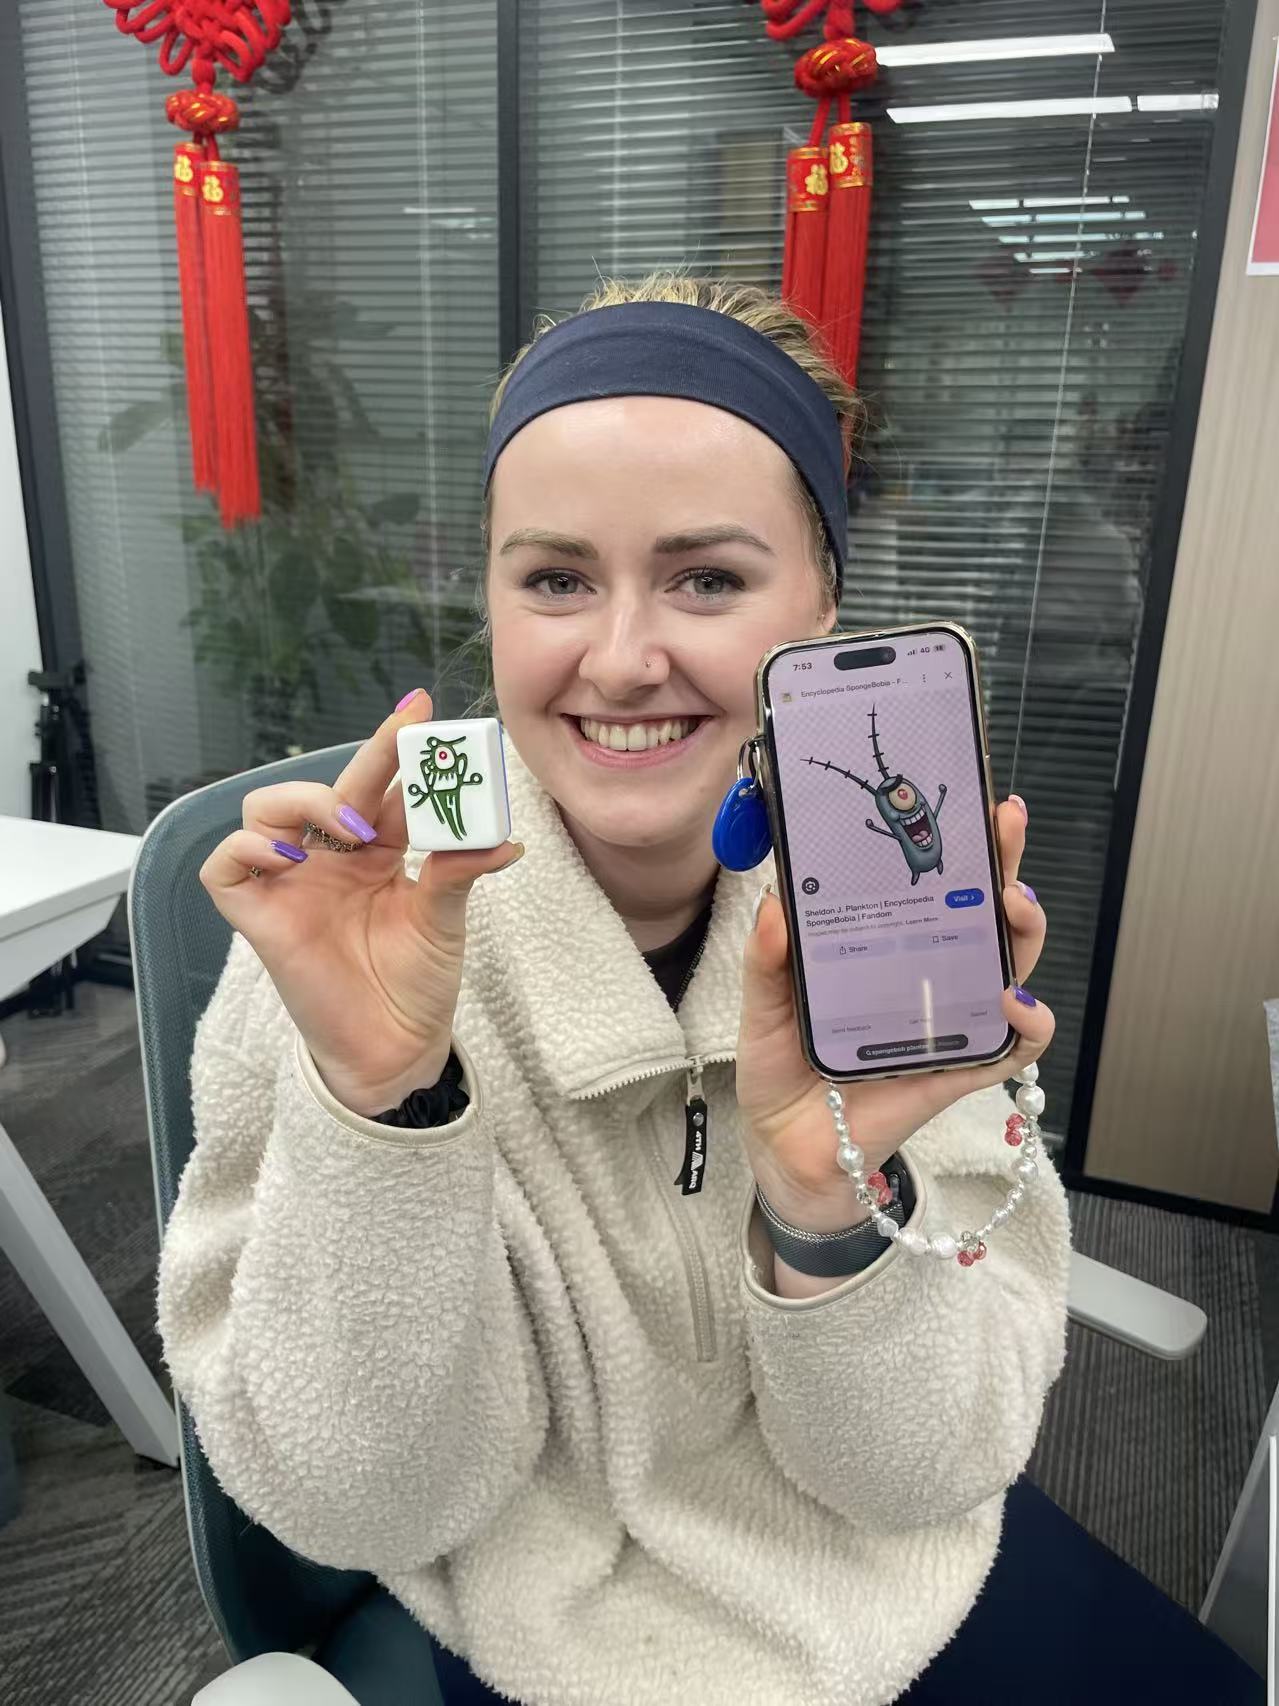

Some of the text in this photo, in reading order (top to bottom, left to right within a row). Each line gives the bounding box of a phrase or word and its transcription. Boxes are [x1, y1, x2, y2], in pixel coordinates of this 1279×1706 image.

[793, 662, 813, 671] 7:53
[801, 687, 845, 698] Encyclopedia
[846, 680, 891, 692] SpongeBobia
[805, 908, 836, 917] Sheldon
[845, 902, 879, 912] Plankton
[884, 895, 935, 908] Encyclopedia
[806, 916, 857, 927] SpongeBobia
[861, 910, 893, 920] Fandom
[941, 934, 958, 942] Save
[848, 945, 868, 953] Share
